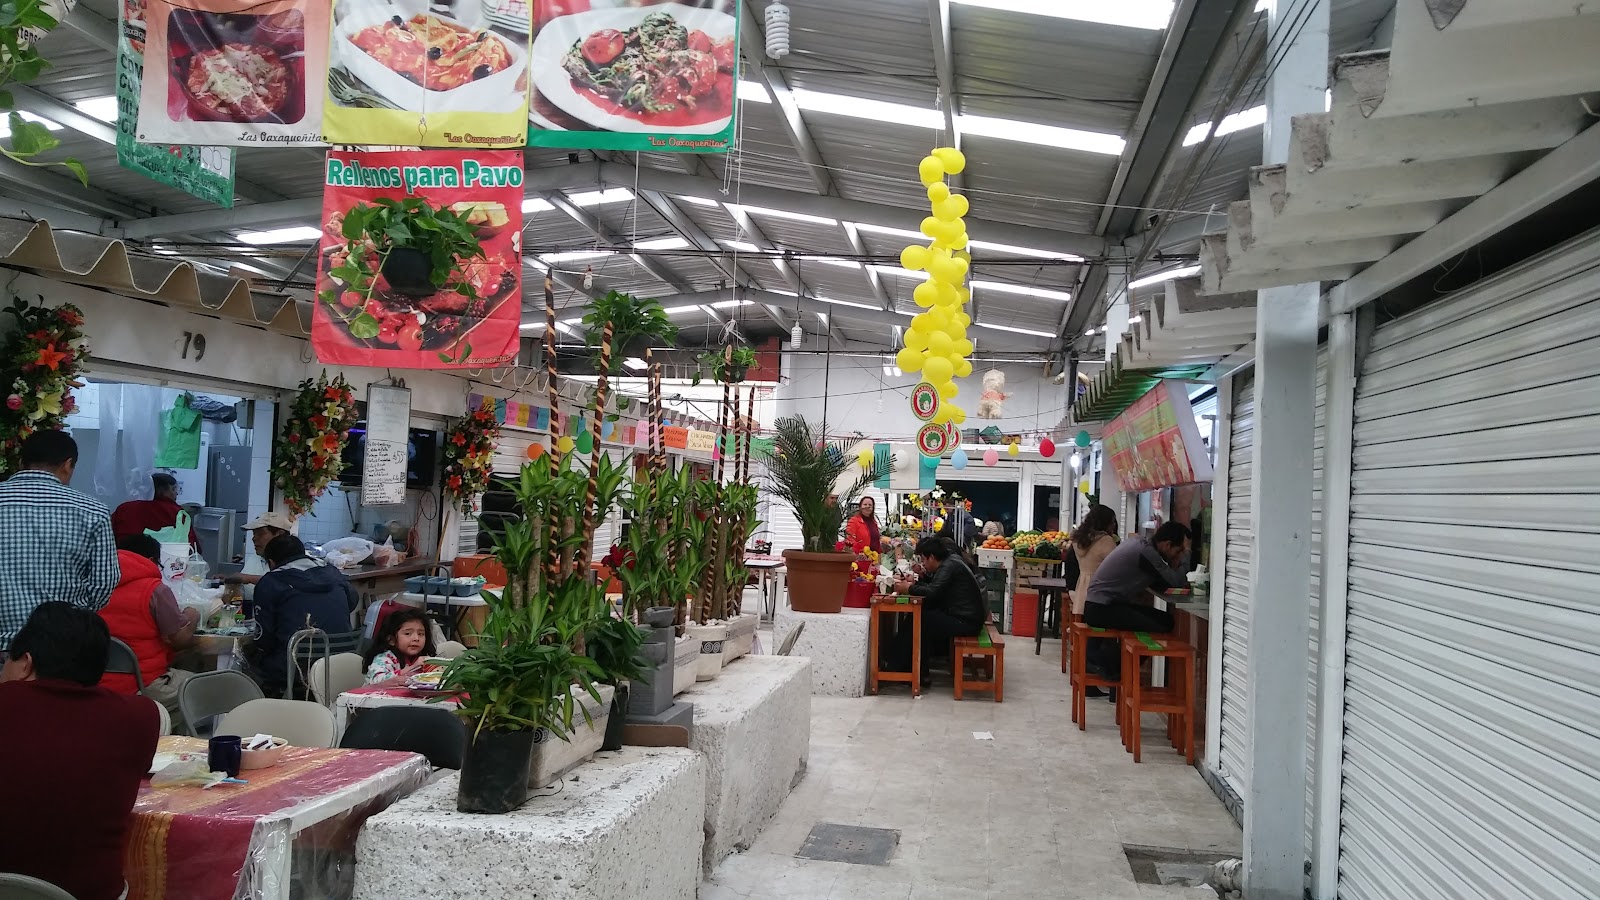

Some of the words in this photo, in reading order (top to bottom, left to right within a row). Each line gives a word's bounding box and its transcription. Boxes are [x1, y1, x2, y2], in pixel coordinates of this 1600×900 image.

[238, 131, 257, 142] Las
[327, 159, 401, 187] Rellenos
[403, 166, 460, 195] para
[462, 159, 523, 188] Pavo
[181, 331, 206, 363] 79
